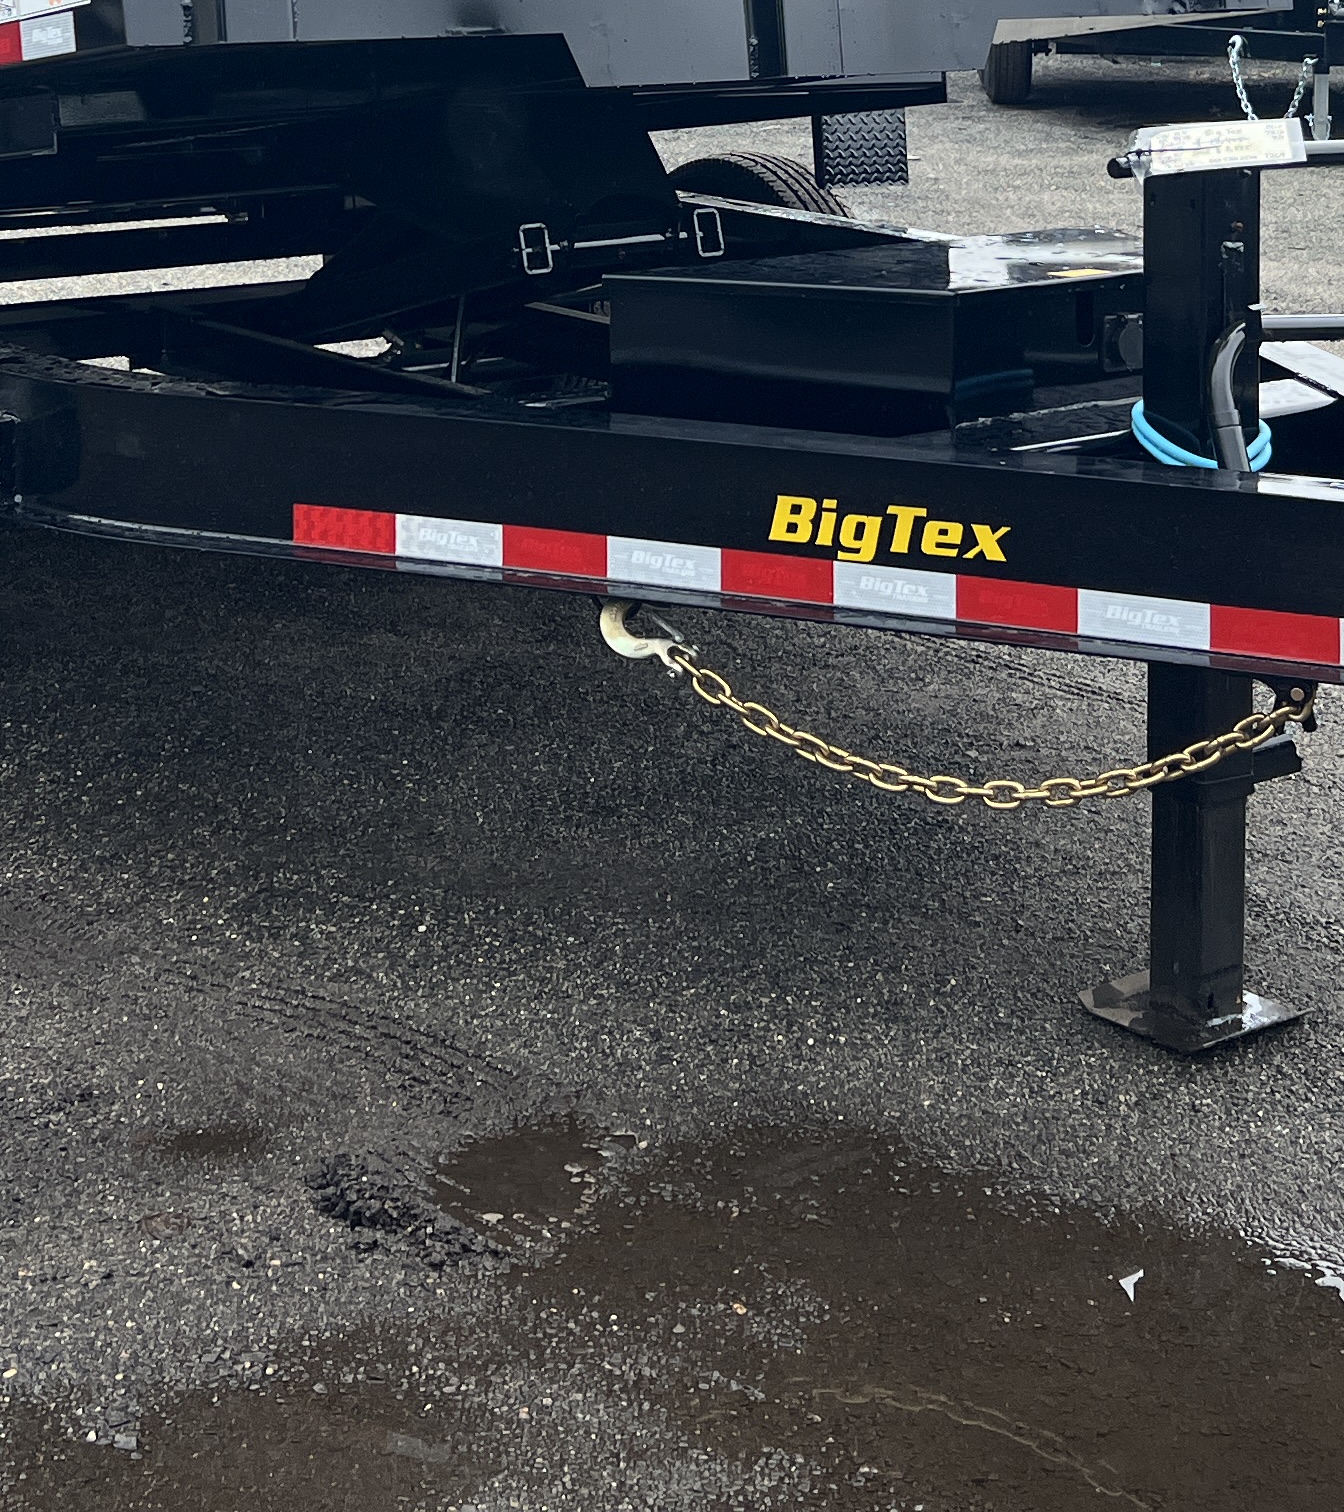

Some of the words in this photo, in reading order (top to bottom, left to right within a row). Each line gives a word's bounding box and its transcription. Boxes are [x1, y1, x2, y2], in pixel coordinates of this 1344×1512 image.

[418, 527, 480, 549] BigTex
[768, 493, 1012, 563] BigTex
[630, 549, 697, 571] BigTex
[859, 575, 929, 597] BigTex
[1104, 604, 1184, 626] BigTex
